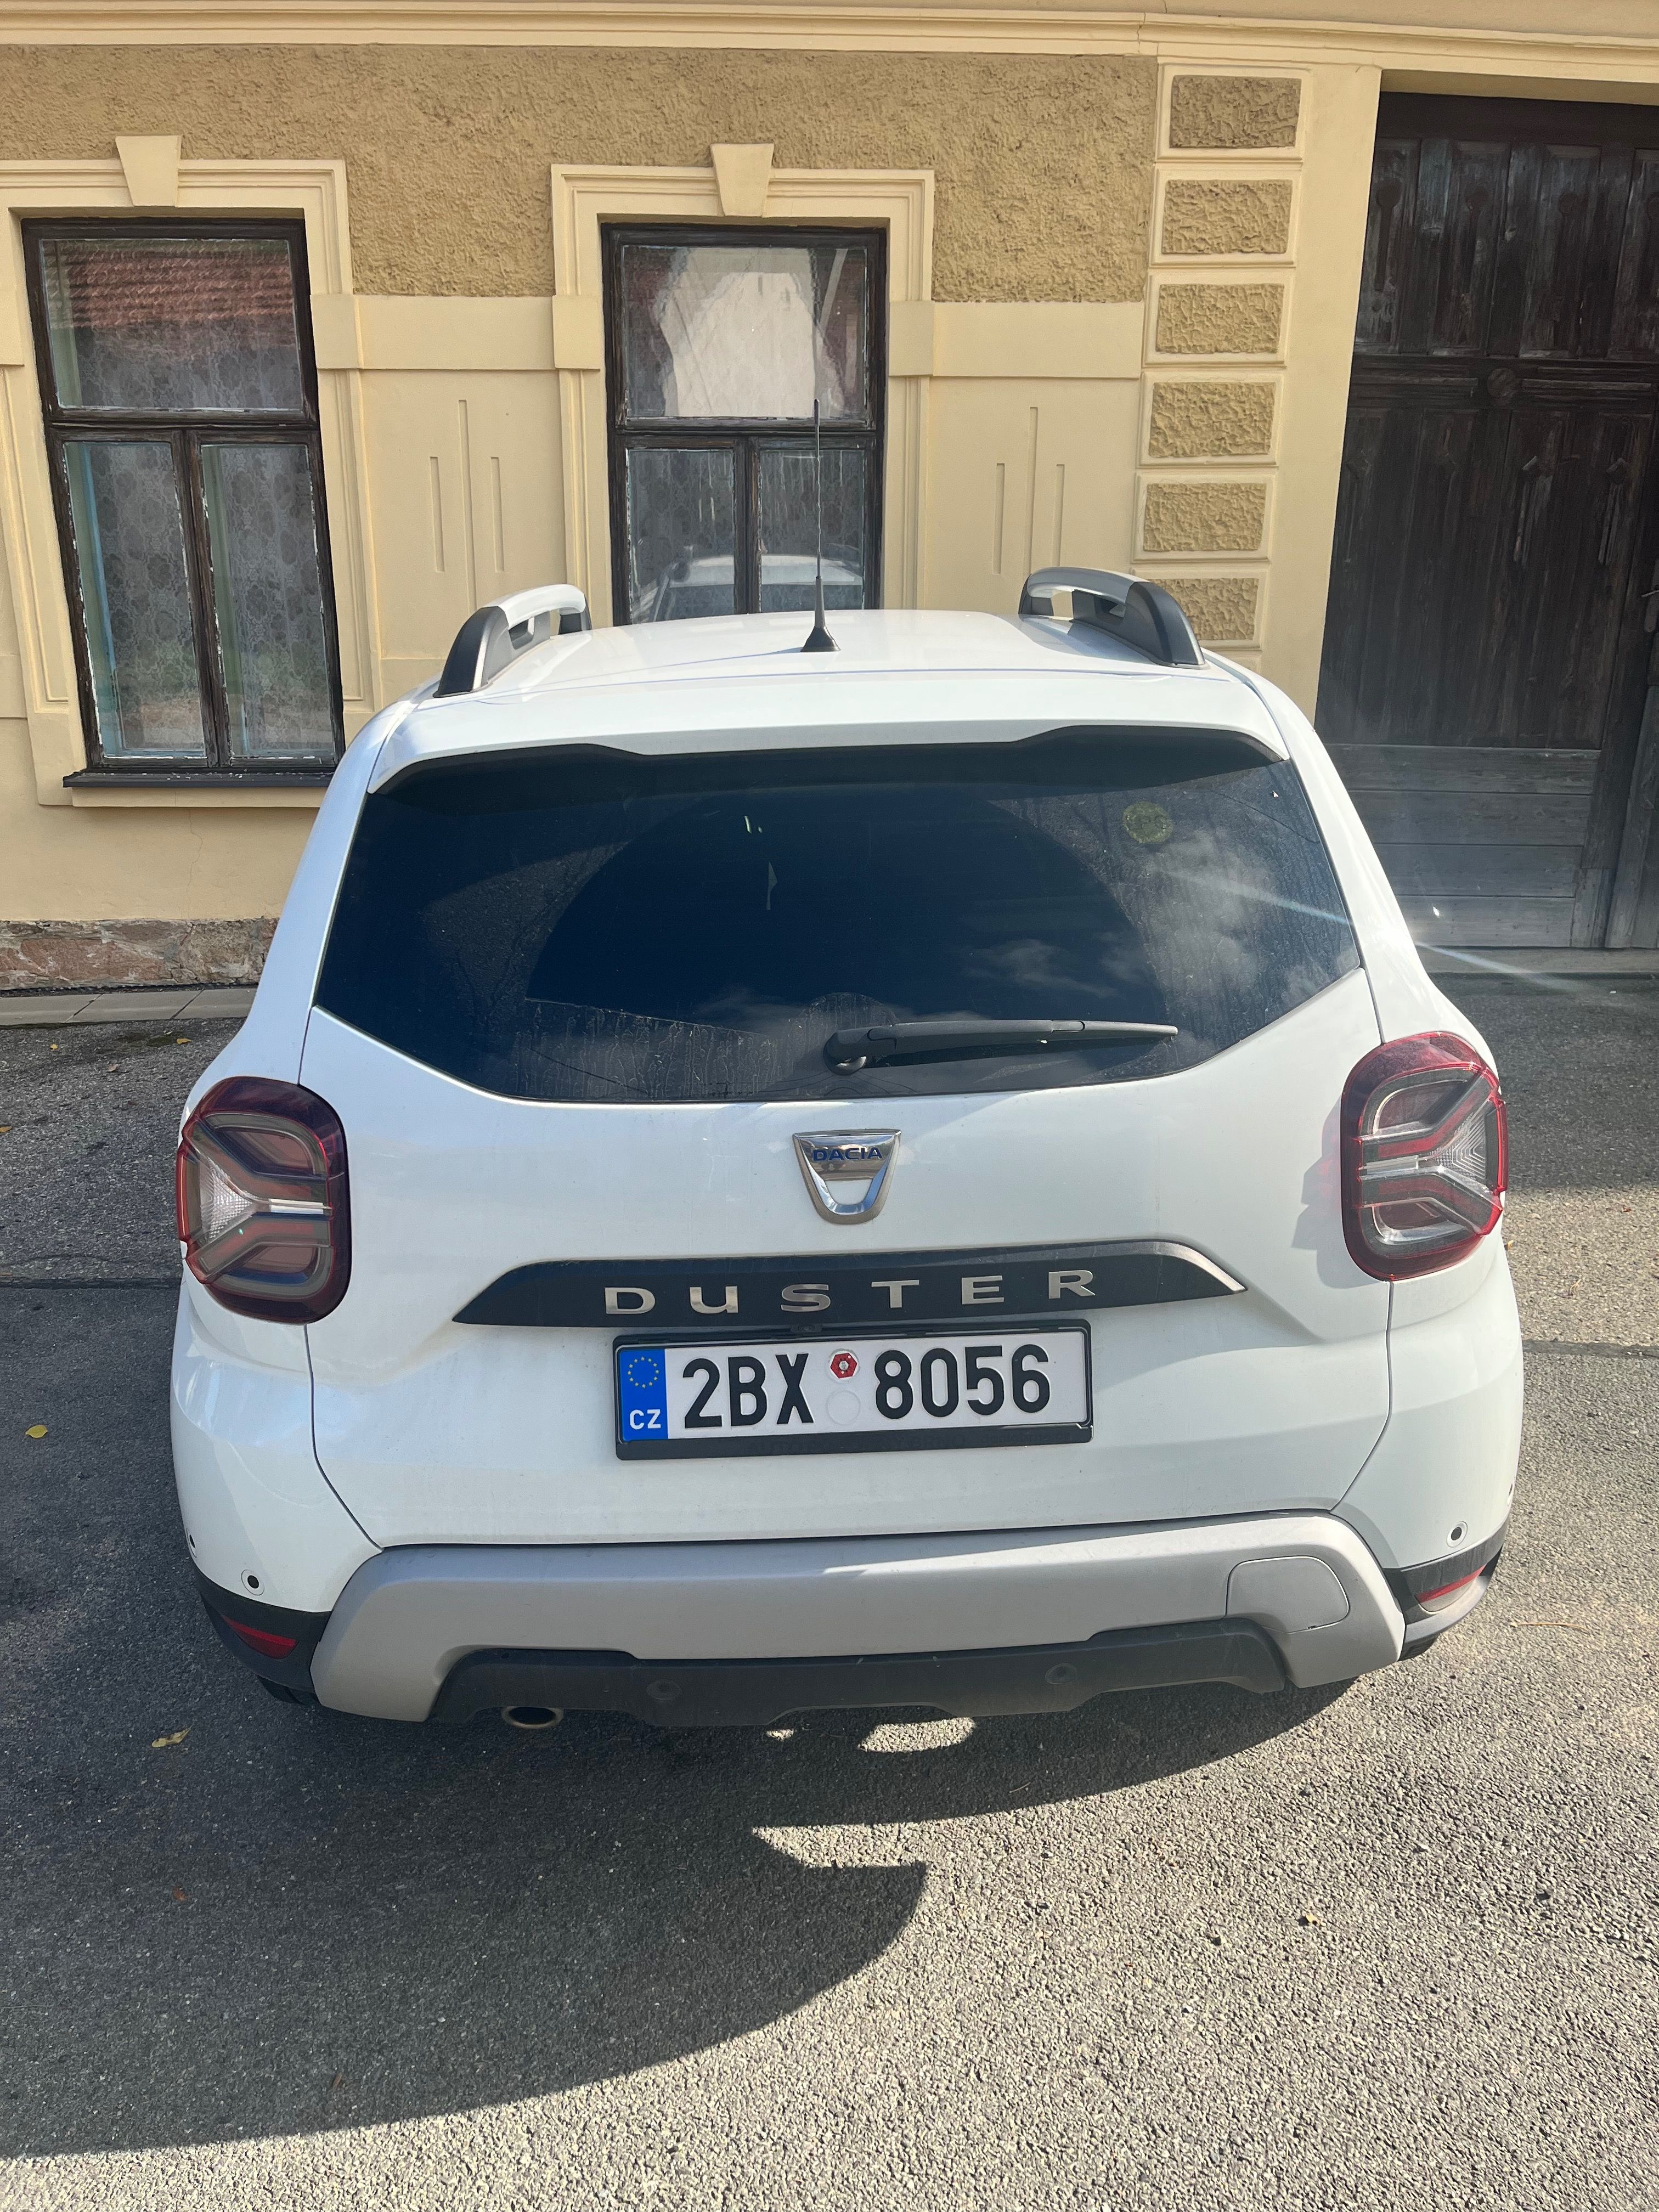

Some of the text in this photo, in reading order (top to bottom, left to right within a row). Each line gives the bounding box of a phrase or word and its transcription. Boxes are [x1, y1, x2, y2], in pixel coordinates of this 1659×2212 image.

[812, 1147, 883, 1161] DACIA
[604, 1269, 1096, 1314] DUSTER
[682, 1344, 1050, 1429] 2BX 8056
[629, 1409, 661, 1429] CZ
